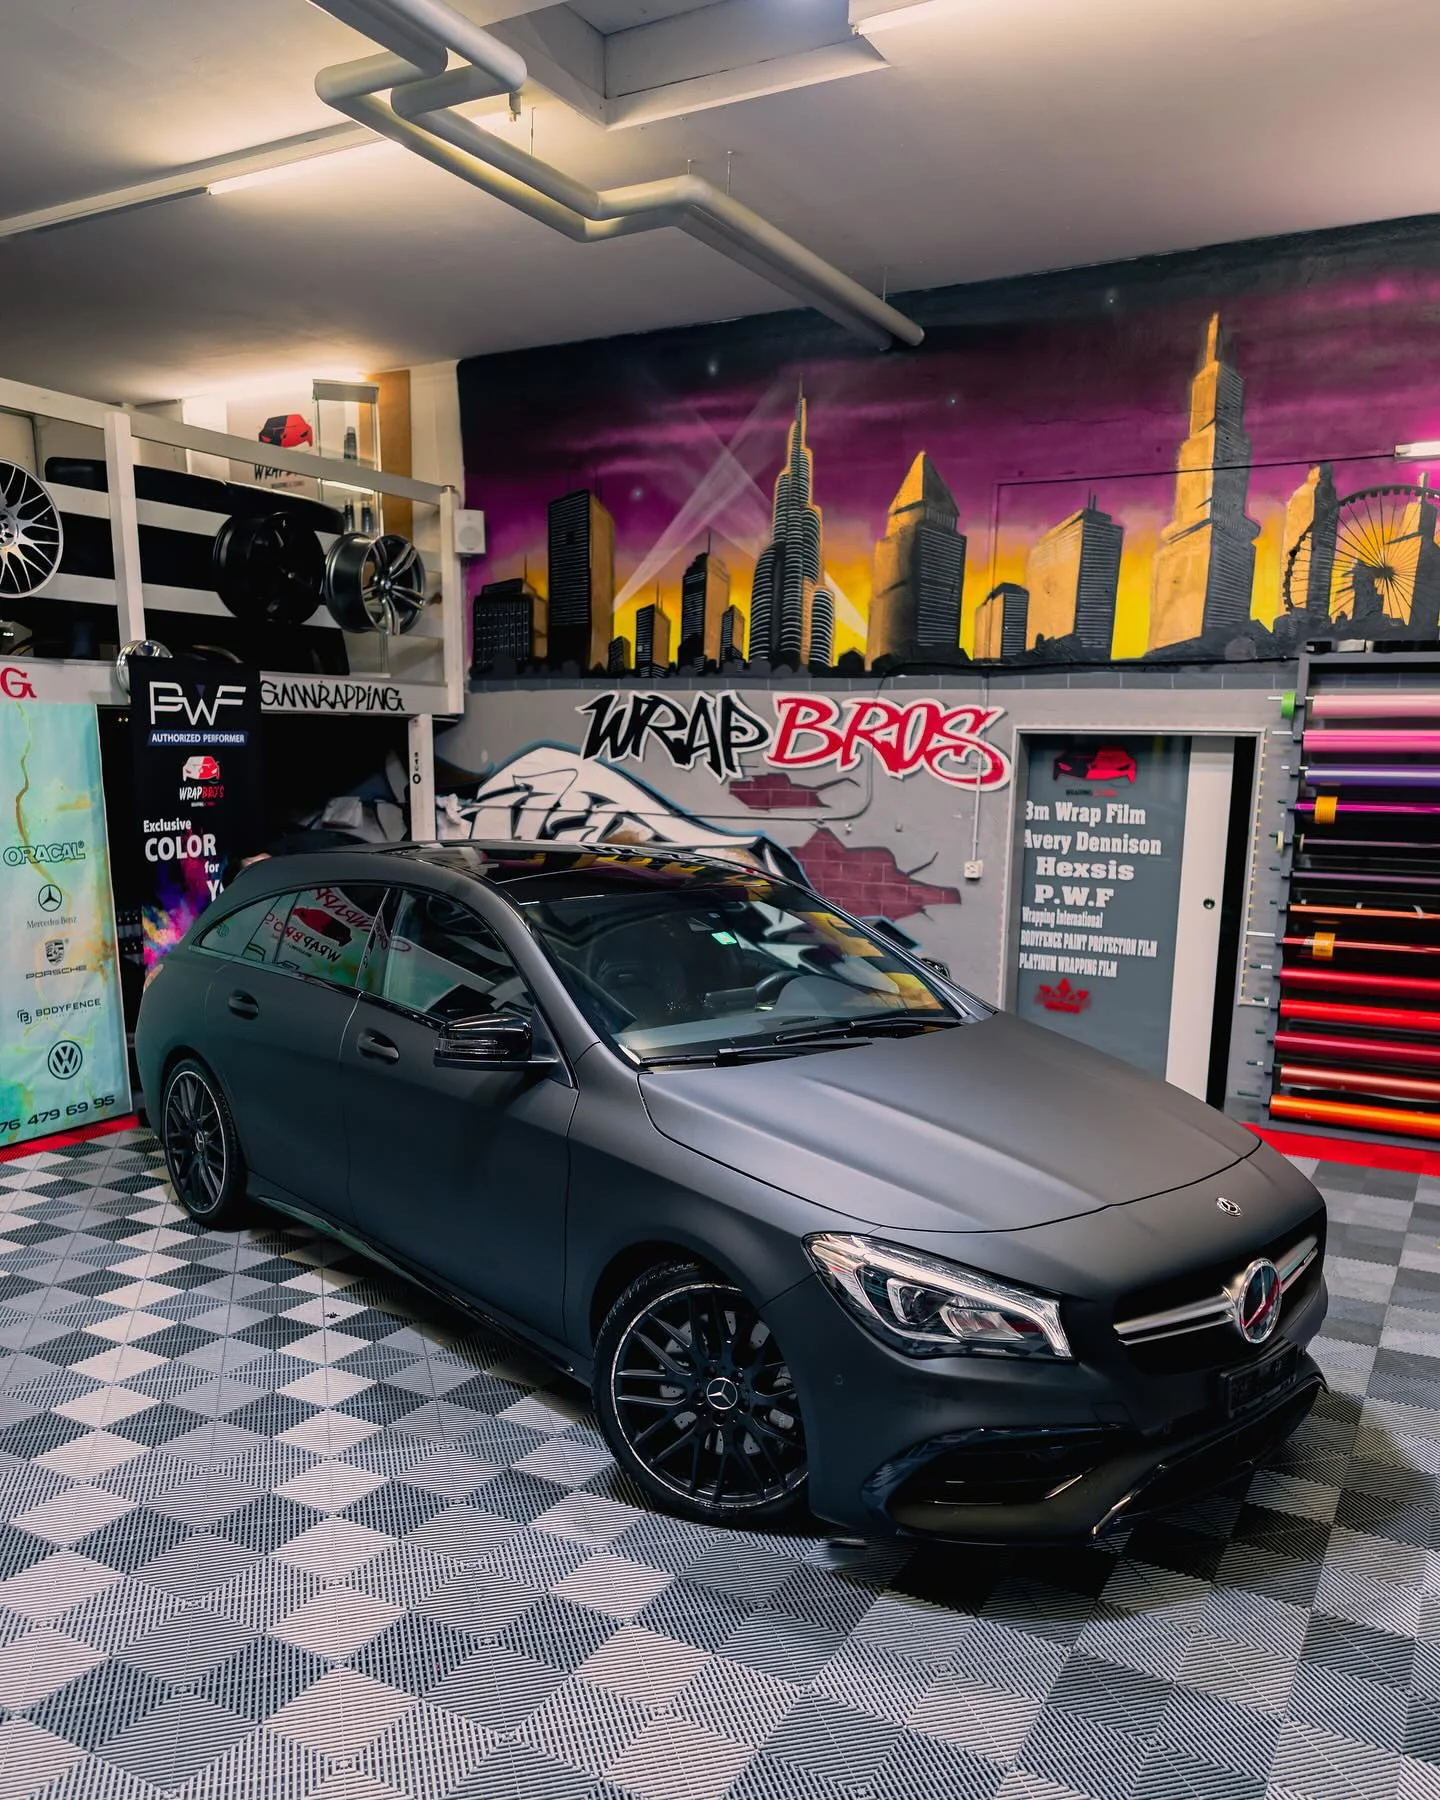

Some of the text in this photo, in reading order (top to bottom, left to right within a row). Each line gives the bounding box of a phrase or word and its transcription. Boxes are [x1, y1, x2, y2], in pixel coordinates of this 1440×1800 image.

[149, 681, 247, 726] PWF
[152, 733, 245, 743] AUTHORIZED PERFORMER
[580, 692, 1009, 788] WRAP BROS
[143, 817, 192, 833] Exclusive
[1025, 800, 1146, 828] 3m Wrap Film
[145, 833, 217, 862] COLOR
[1024, 829, 1162, 856] Avery Dennison
[204, 861, 220, 873] for
[1036, 856, 1135, 881] Hexsis
[1034, 884, 1115, 908] P.W.F
[1022, 906, 1103, 929] Wrapping International
[1021, 929, 1158, 958] BODYFENCE PAINT PROTECTION FILM
[26, 964, 87, 980] PORSCHE
[1019, 952, 1118, 977] PLATINUM WRAPPING FILM
[35, 998, 101, 1017] BODYFENCE
[27, 1109, 60, 1125] 479
[66, 1102, 89, 1116] 69
[93, 1095, 115, 1107] 95
